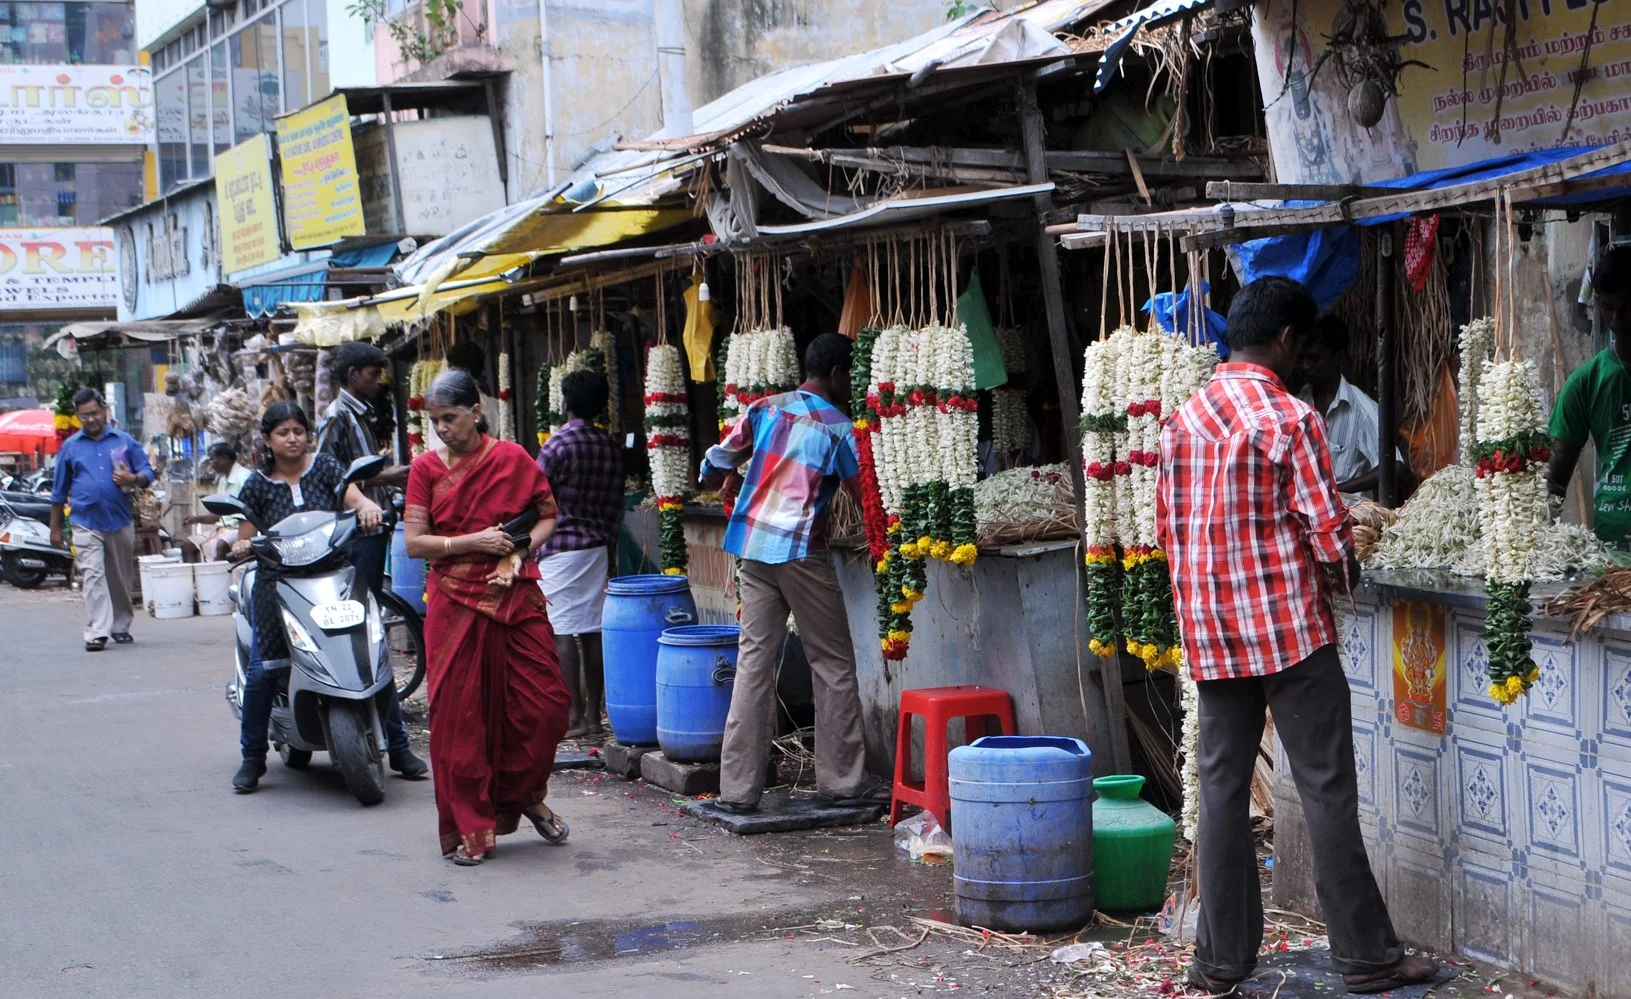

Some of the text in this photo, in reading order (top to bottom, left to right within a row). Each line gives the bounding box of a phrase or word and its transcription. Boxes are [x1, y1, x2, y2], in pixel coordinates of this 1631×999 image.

[325, 603, 352, 613] TN 22
[340, 614, 360, 623] 2071
